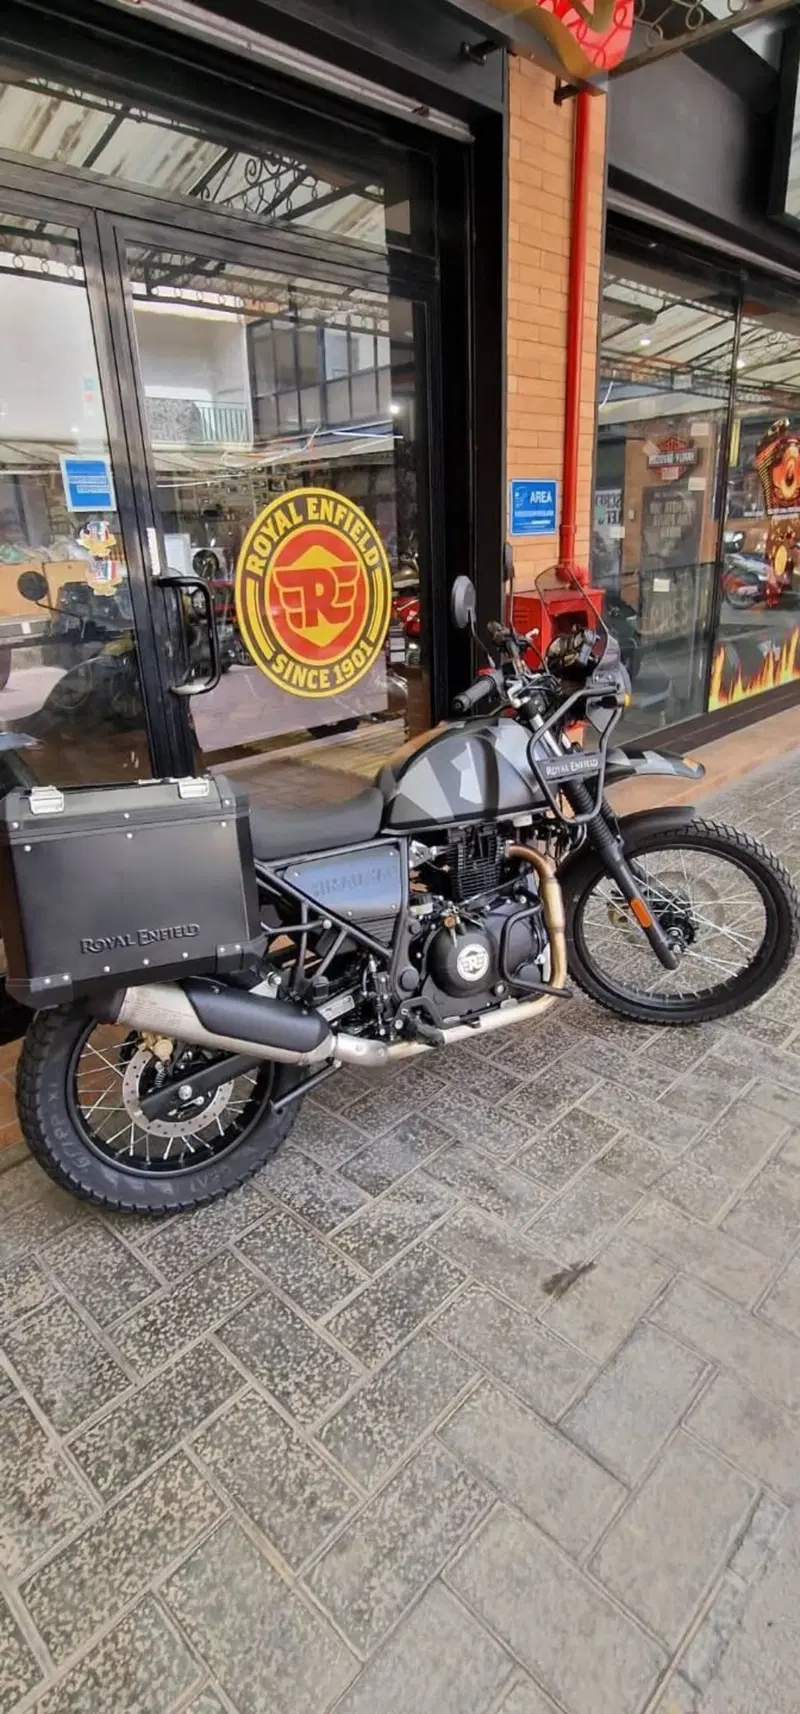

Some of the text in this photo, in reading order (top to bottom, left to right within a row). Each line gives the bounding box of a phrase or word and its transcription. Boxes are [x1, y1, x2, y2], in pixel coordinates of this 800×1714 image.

[529, 490, 553, 505] AREA
[245, 497, 382, 577] ROYAL ENFIELD
[271, 640, 374, 690] SINCE 1901
[546, 758, 599, 776] ROYAL ENFIELD
[80, 923, 201, 955] ROYAL ENFIELD
